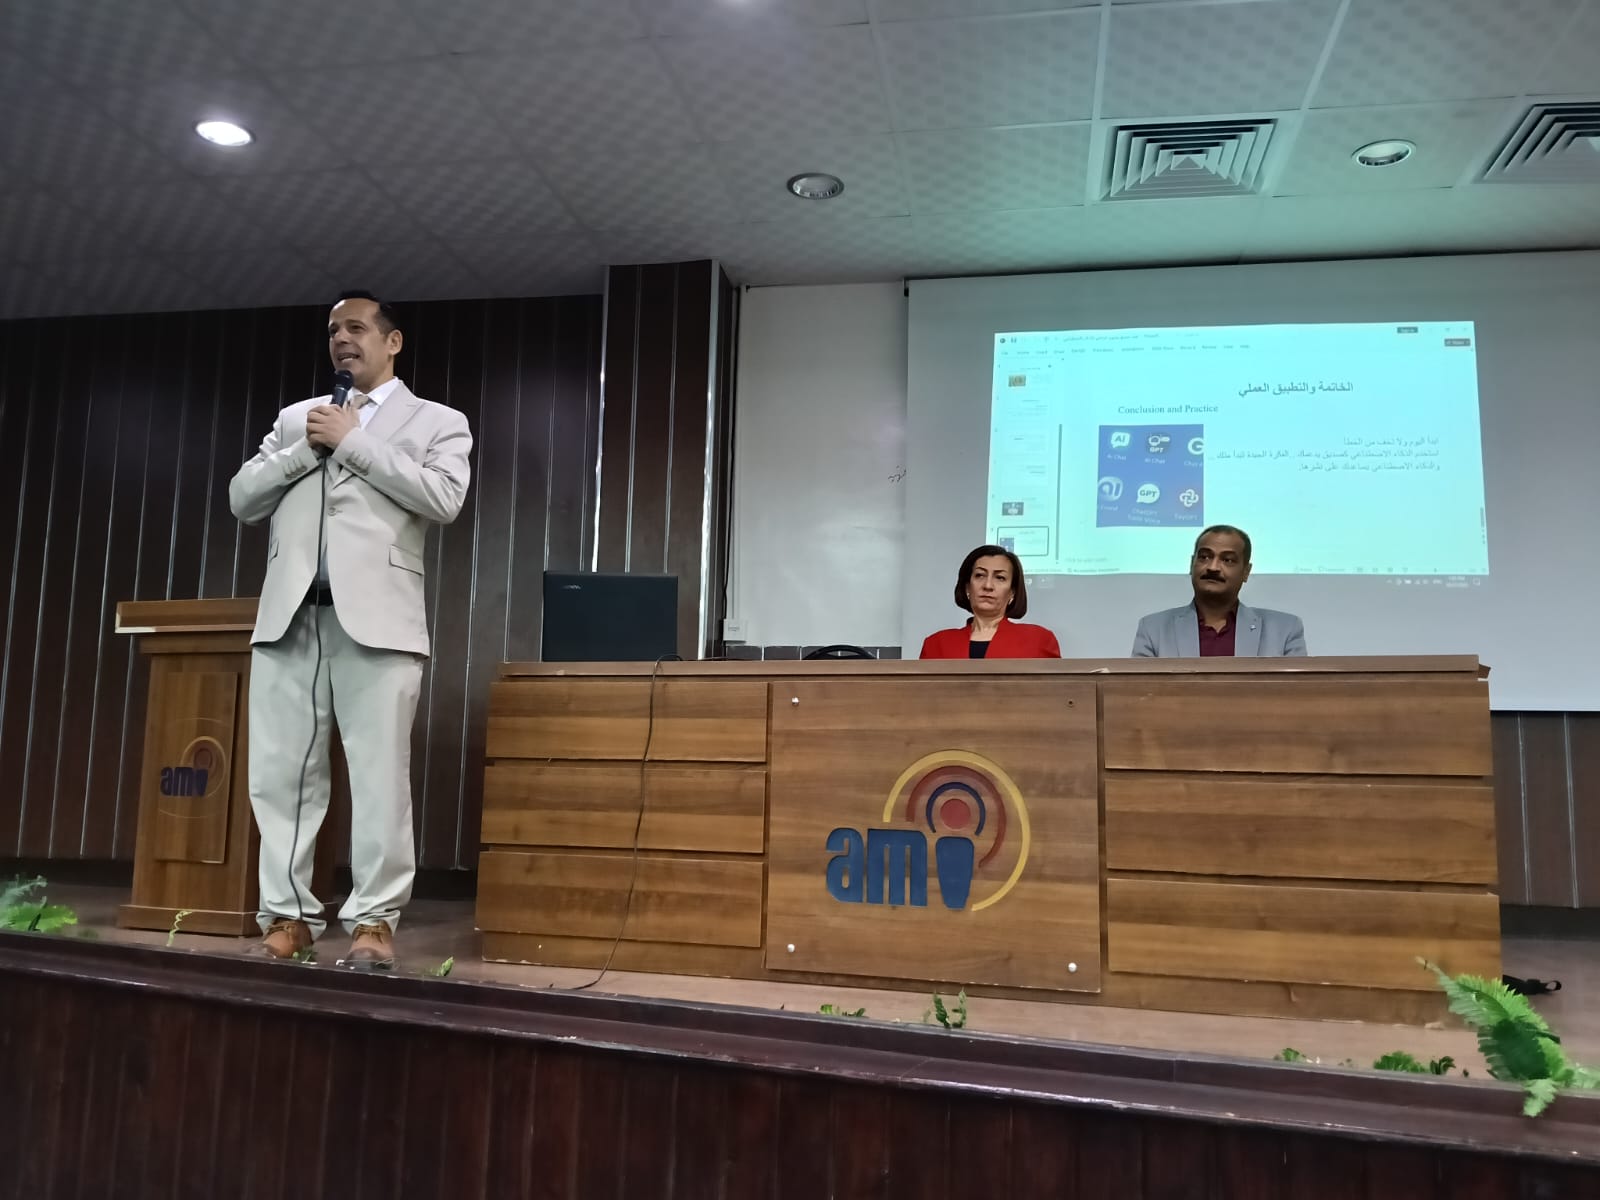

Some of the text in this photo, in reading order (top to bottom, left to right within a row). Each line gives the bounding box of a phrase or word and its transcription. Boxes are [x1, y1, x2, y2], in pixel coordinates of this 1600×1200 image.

[1238, 379, 1354, 398] الخاتمة والتطبيق العملي
[1117, 403, 1219, 414] Conclusion and Practice
[825, 798, 975, 912] ami
